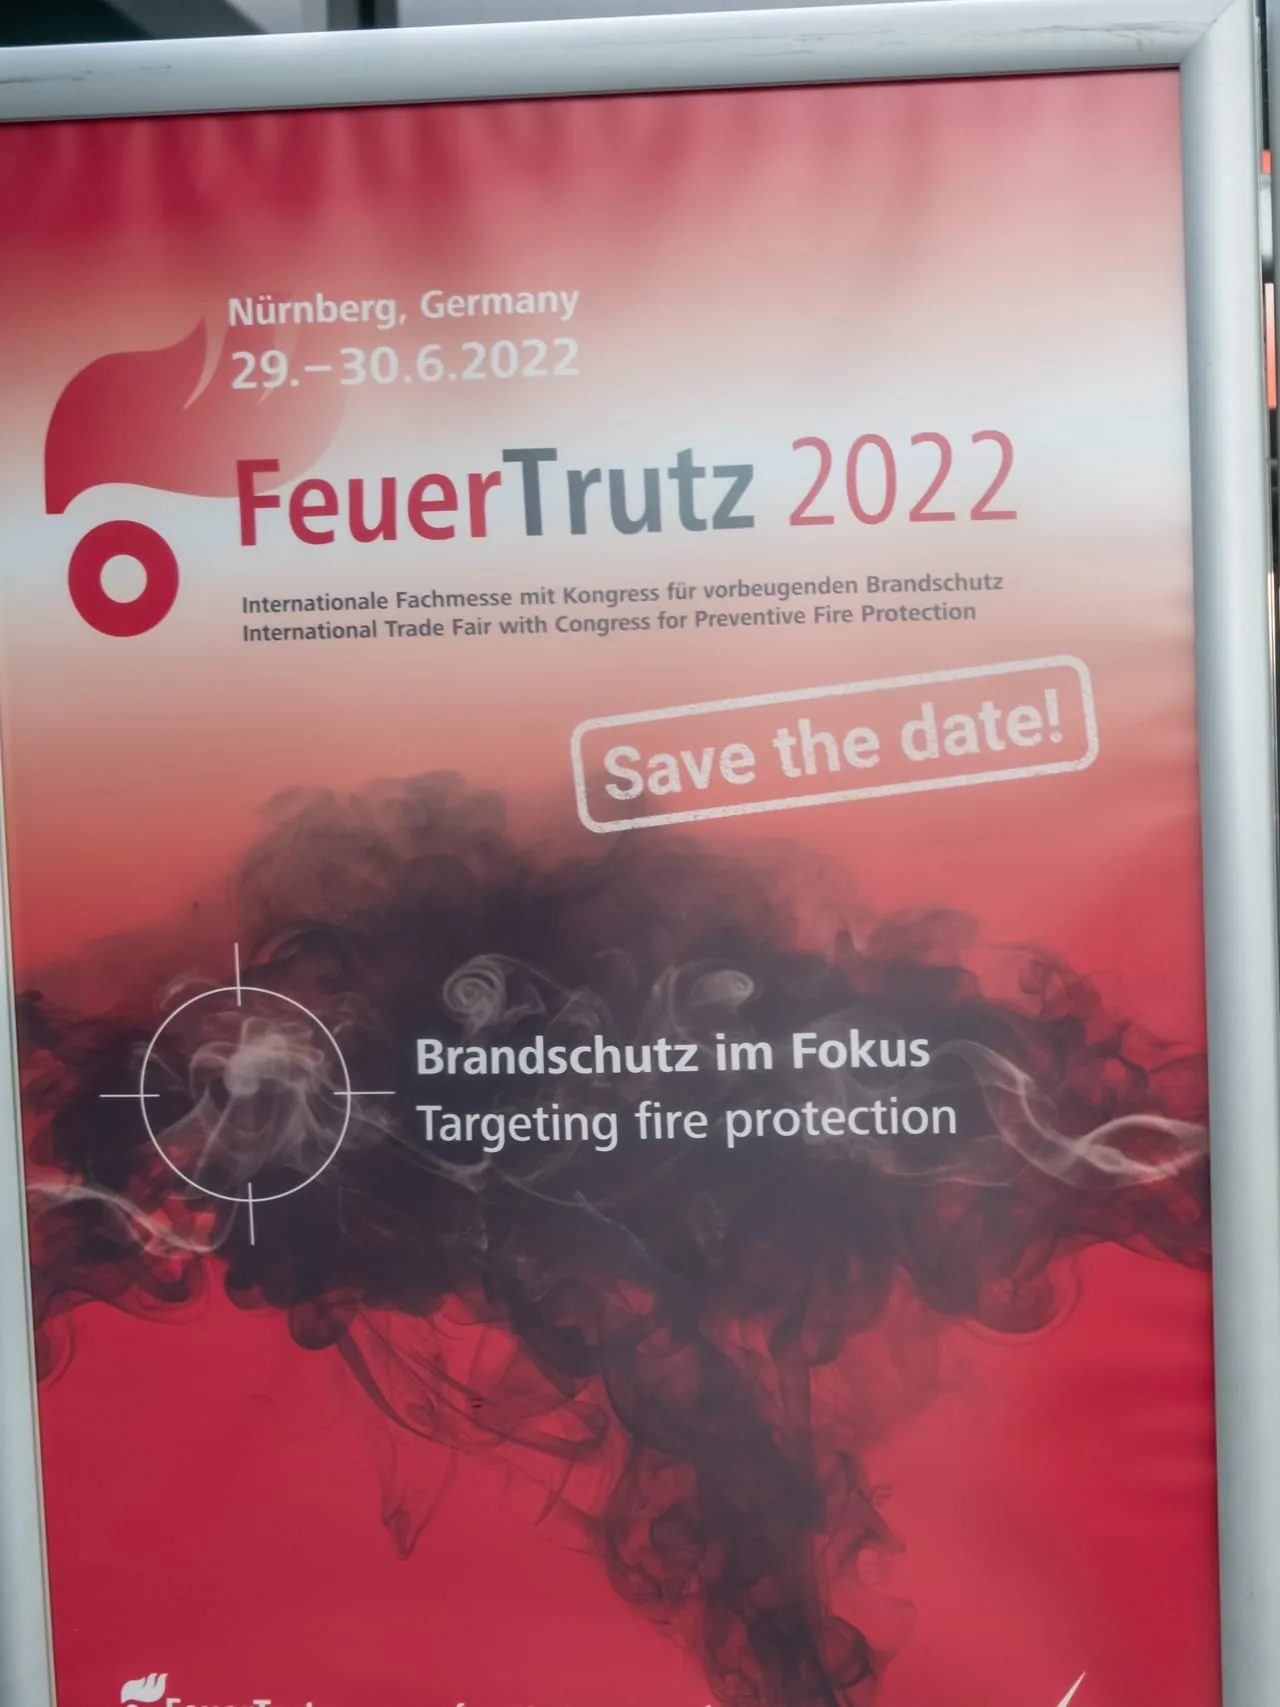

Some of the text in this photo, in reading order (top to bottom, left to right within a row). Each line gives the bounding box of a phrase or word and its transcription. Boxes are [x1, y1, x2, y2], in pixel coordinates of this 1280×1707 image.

[228, 287, 580, 329] Nürnberg, Germany
[236, 429, 1018, 547] FeuerTrutz 2022
[242, 572, 1004, 614] Internationale Fachmesse mit Kongress für vorbeugenden Brandschutz
[242, 601, 977, 642] International Trade Fair with Congress for Preventive Fire Protection
[603, 688, 1064, 801] Save the date!
[416, 1029, 931, 1075] Brandschutz im Fokus
[416, 1097, 958, 1153] Targeting fire protection
